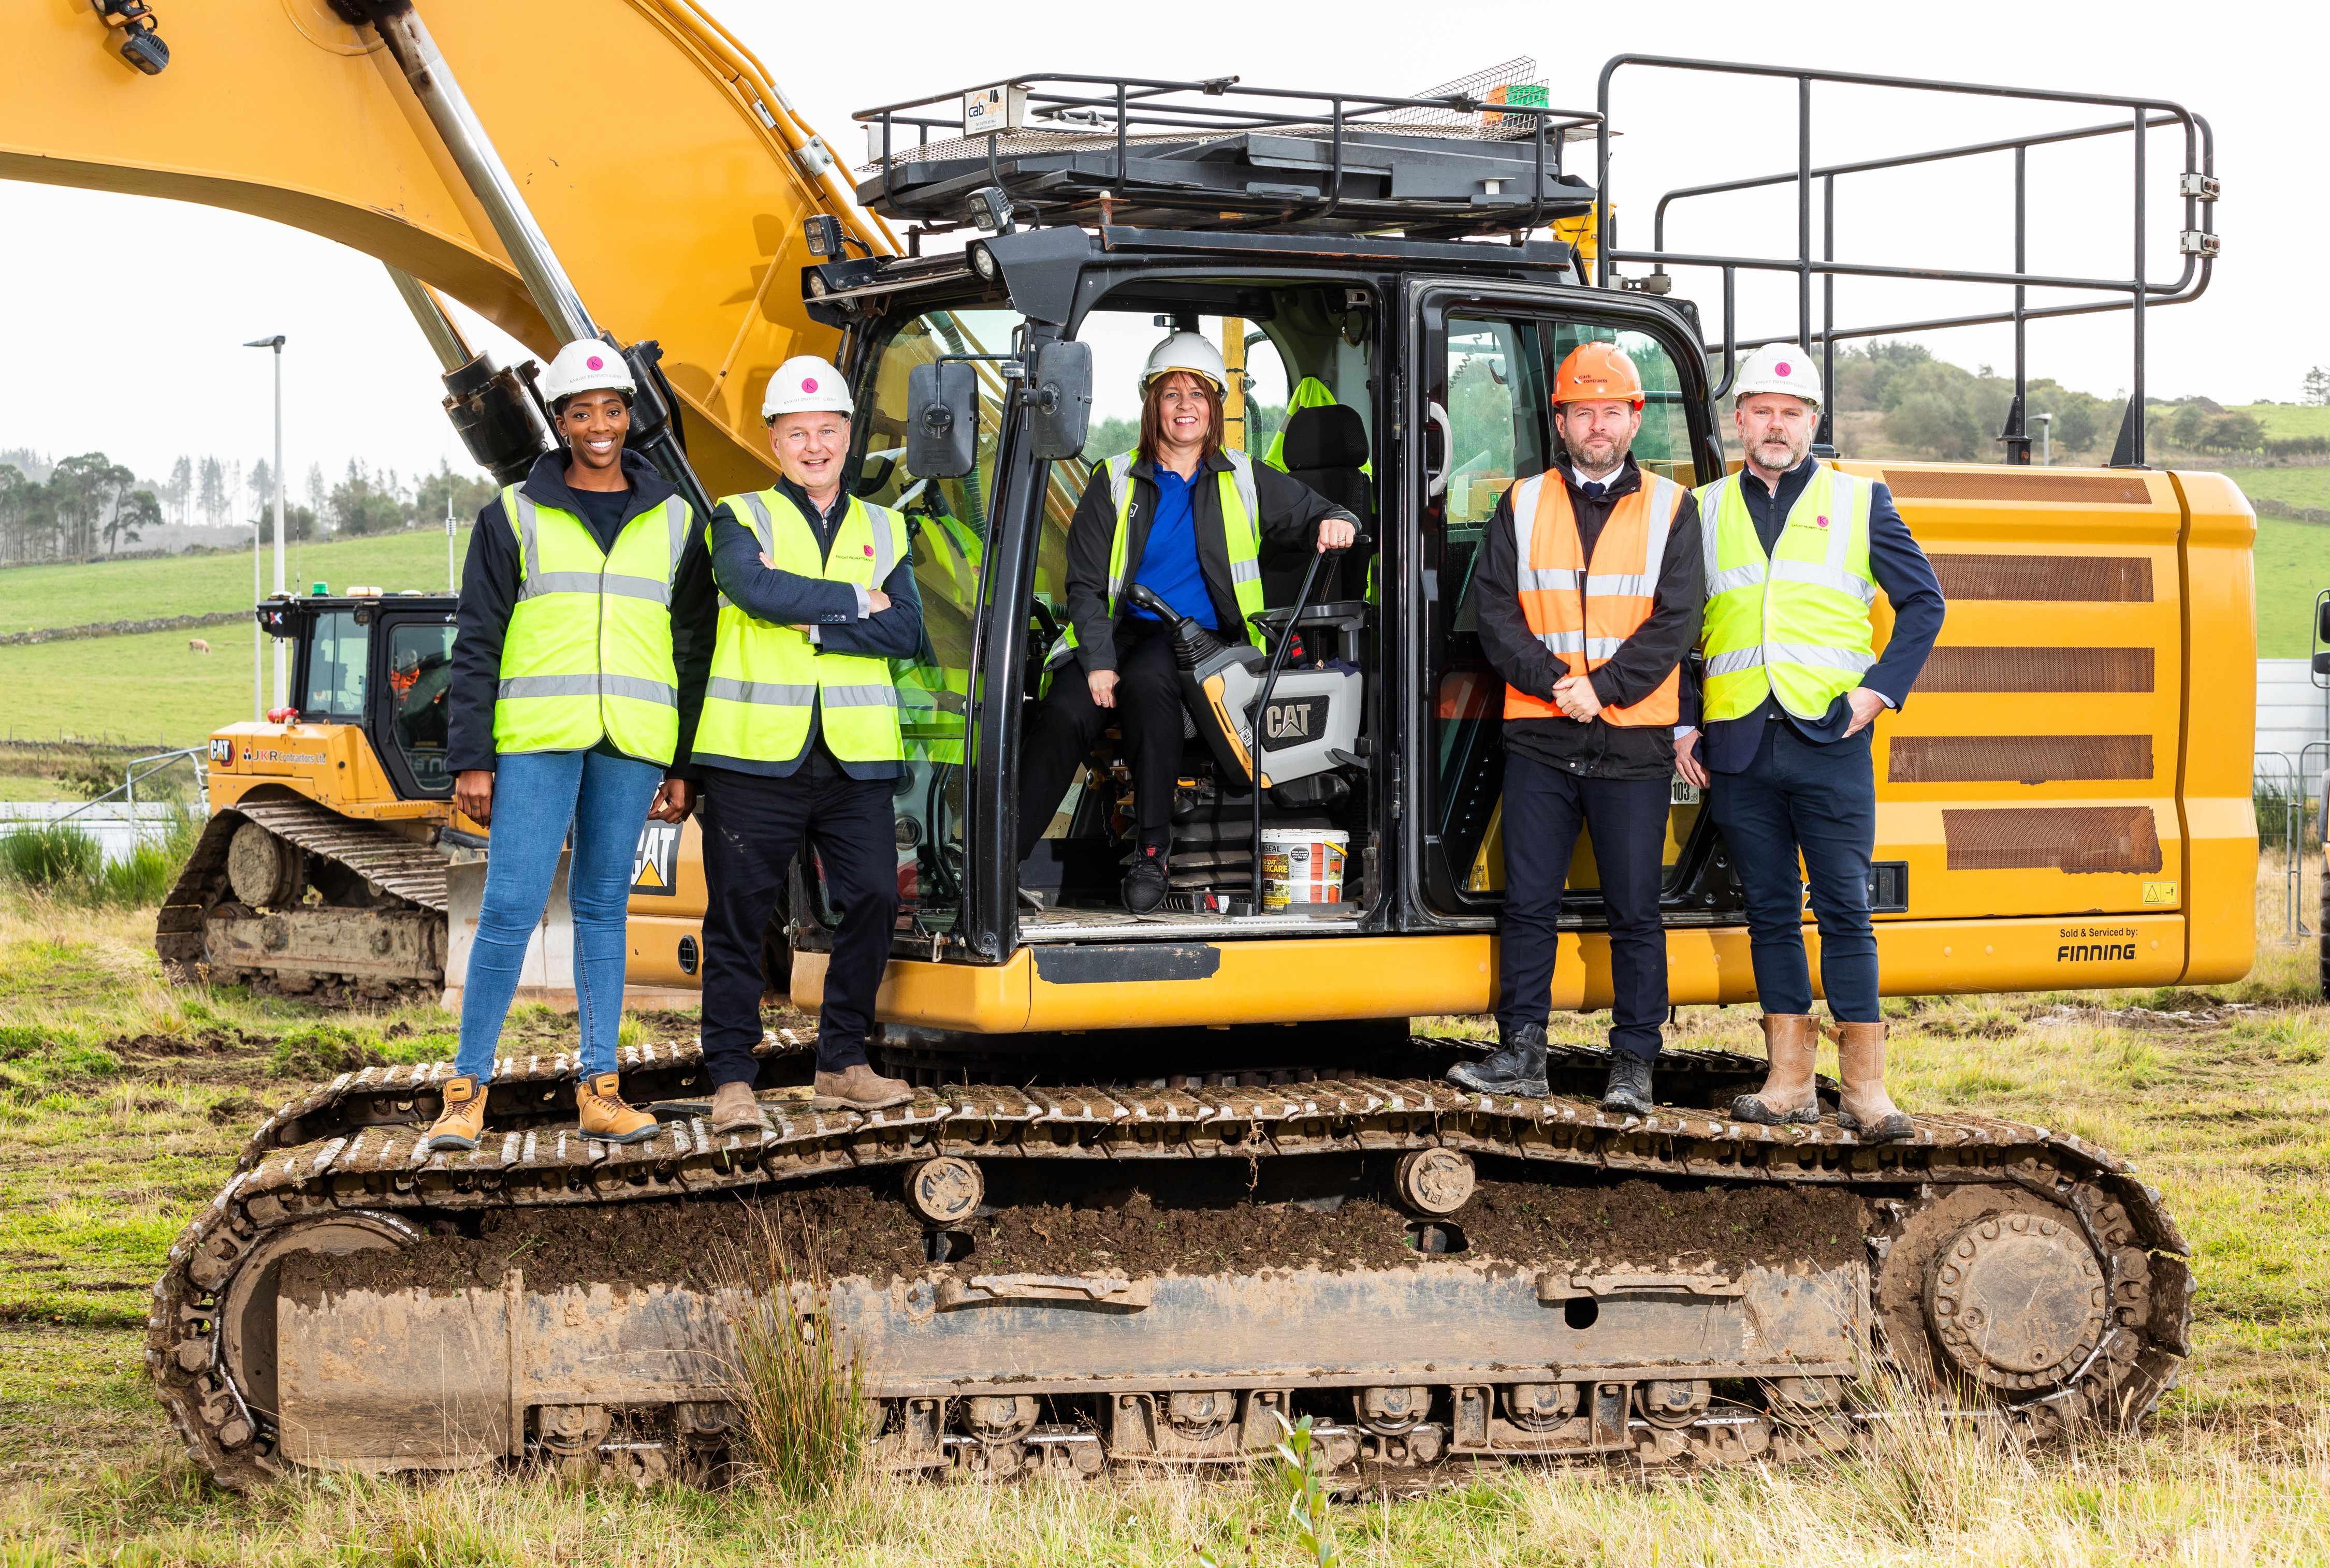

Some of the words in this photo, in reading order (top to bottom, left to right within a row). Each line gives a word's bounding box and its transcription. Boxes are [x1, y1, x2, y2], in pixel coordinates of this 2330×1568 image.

[591, 359, 600, 367] K
[1780, 365, 1787, 373] K
[806, 380, 814, 389] K
[1266, 704, 1311, 738] CAT
[210, 739, 229, 761] CAT
[253, 750, 278, 761] JKR
[279, 752, 314, 763] Contractors
[316, 753, 326, 764] Ltd
[1672, 782, 1690, 801] 103
[1262, 864, 1288, 873] BERCARE
[2060, 929, 2078, 937] Sold
[2080, 928, 2086, 937] &
[2089, 928, 2123, 936] Serviced
[2126, 927, 2138, 938] by:
[2057, 944, 2136, 962] FINNING
